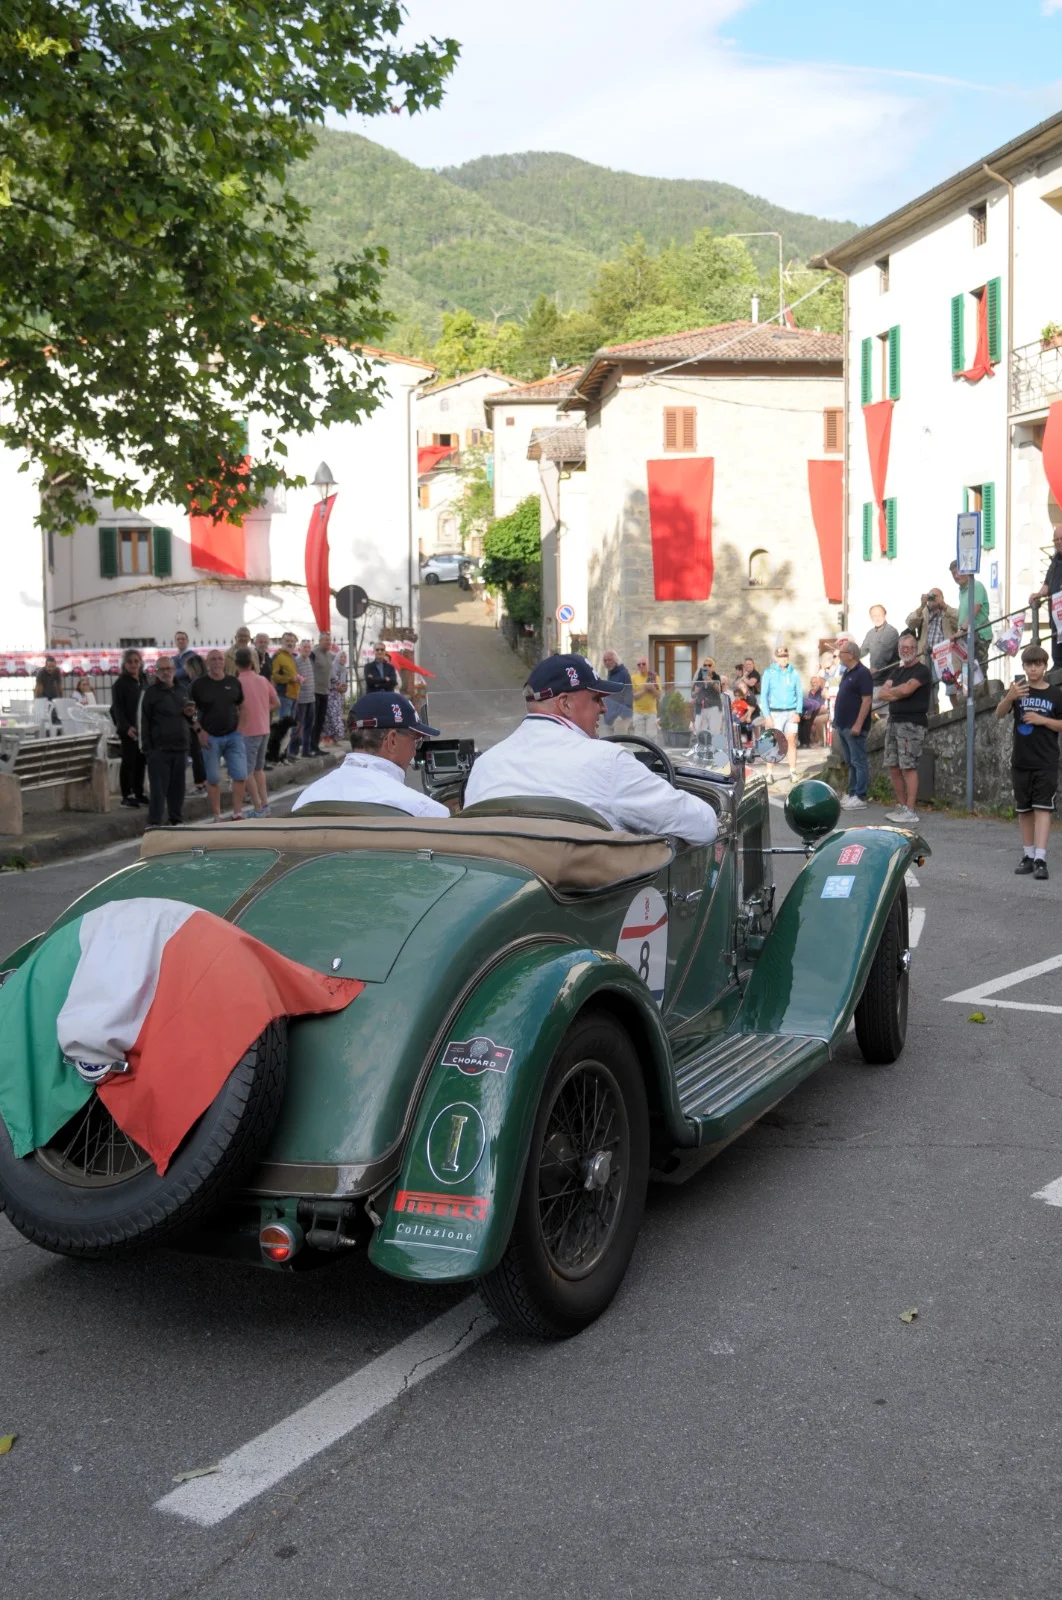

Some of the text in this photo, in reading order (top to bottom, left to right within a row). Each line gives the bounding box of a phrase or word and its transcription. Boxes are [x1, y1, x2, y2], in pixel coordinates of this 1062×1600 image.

[1019, 698, 1053, 711] JORDAN
[639, 940, 649, 983] 8
[452, 1057, 497, 1068] CHOPARD
[441, 1115, 469, 1172] I
[393, 1190, 489, 1222] PIRELLI
[396, 1223, 472, 1241] Collezione
